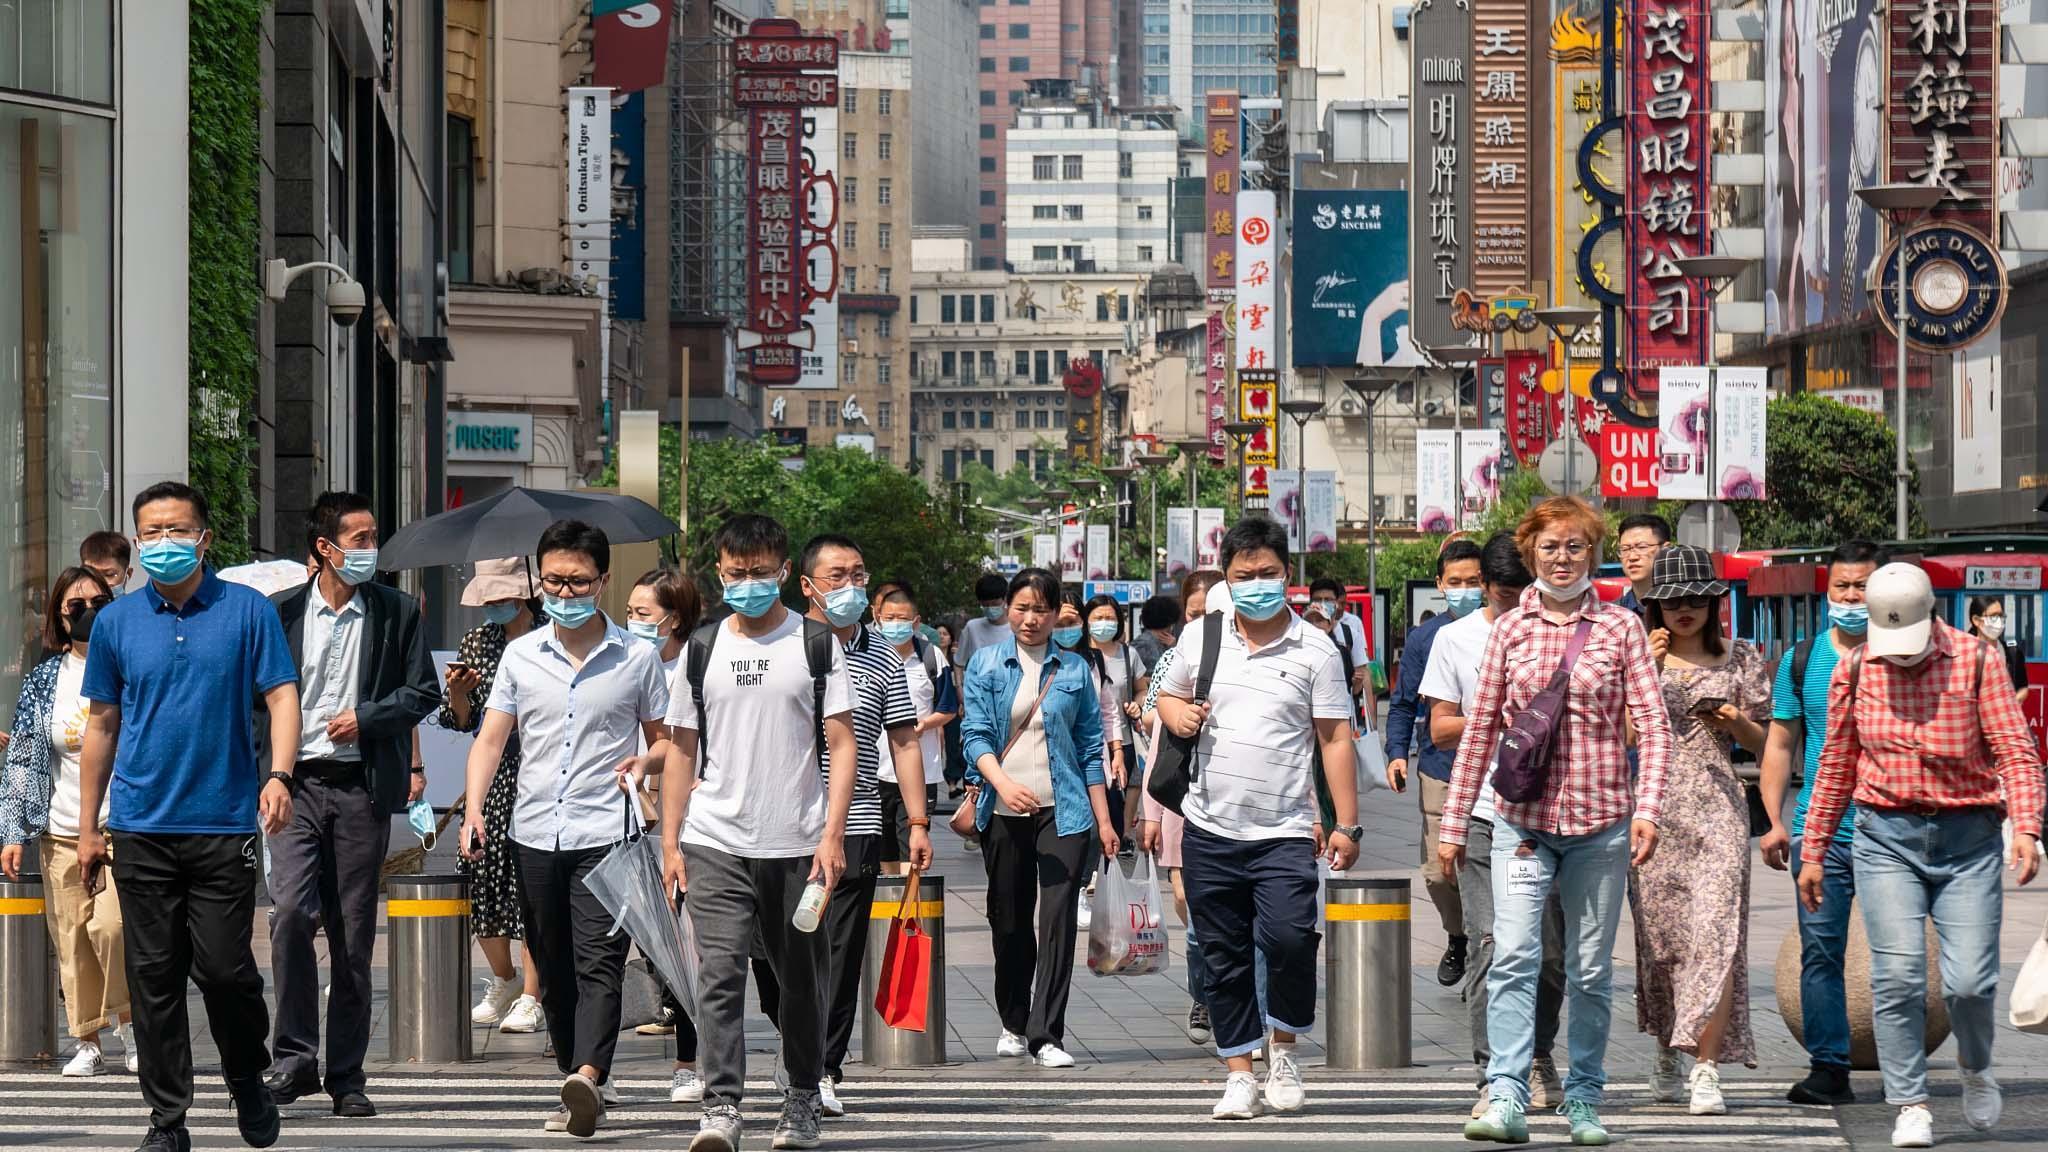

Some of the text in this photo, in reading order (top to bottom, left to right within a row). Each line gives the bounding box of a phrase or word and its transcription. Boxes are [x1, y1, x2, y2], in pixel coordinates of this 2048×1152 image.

[809, 79, 834, 102] 9F
[1481, 28, 1519, 191] 王開照相
[578, 123, 591, 156] Tiger
[578, 158, 588, 213] Onitsuka
[1429, 92, 1459, 300] 明牌珠宝
[1640, 11, 1697, 336] 茂昌眼镜公司
[2002, 156, 2035, 195] OMEGA
[758, 110, 793, 328] 茂昌眼镜验配中心
[1948, 236, 1988, 271] DALI
[1922, 323, 1946, 336] AND
[1952, 284, 1991, 334] WATCHES
[736, 674, 763, 687] RIGHT
